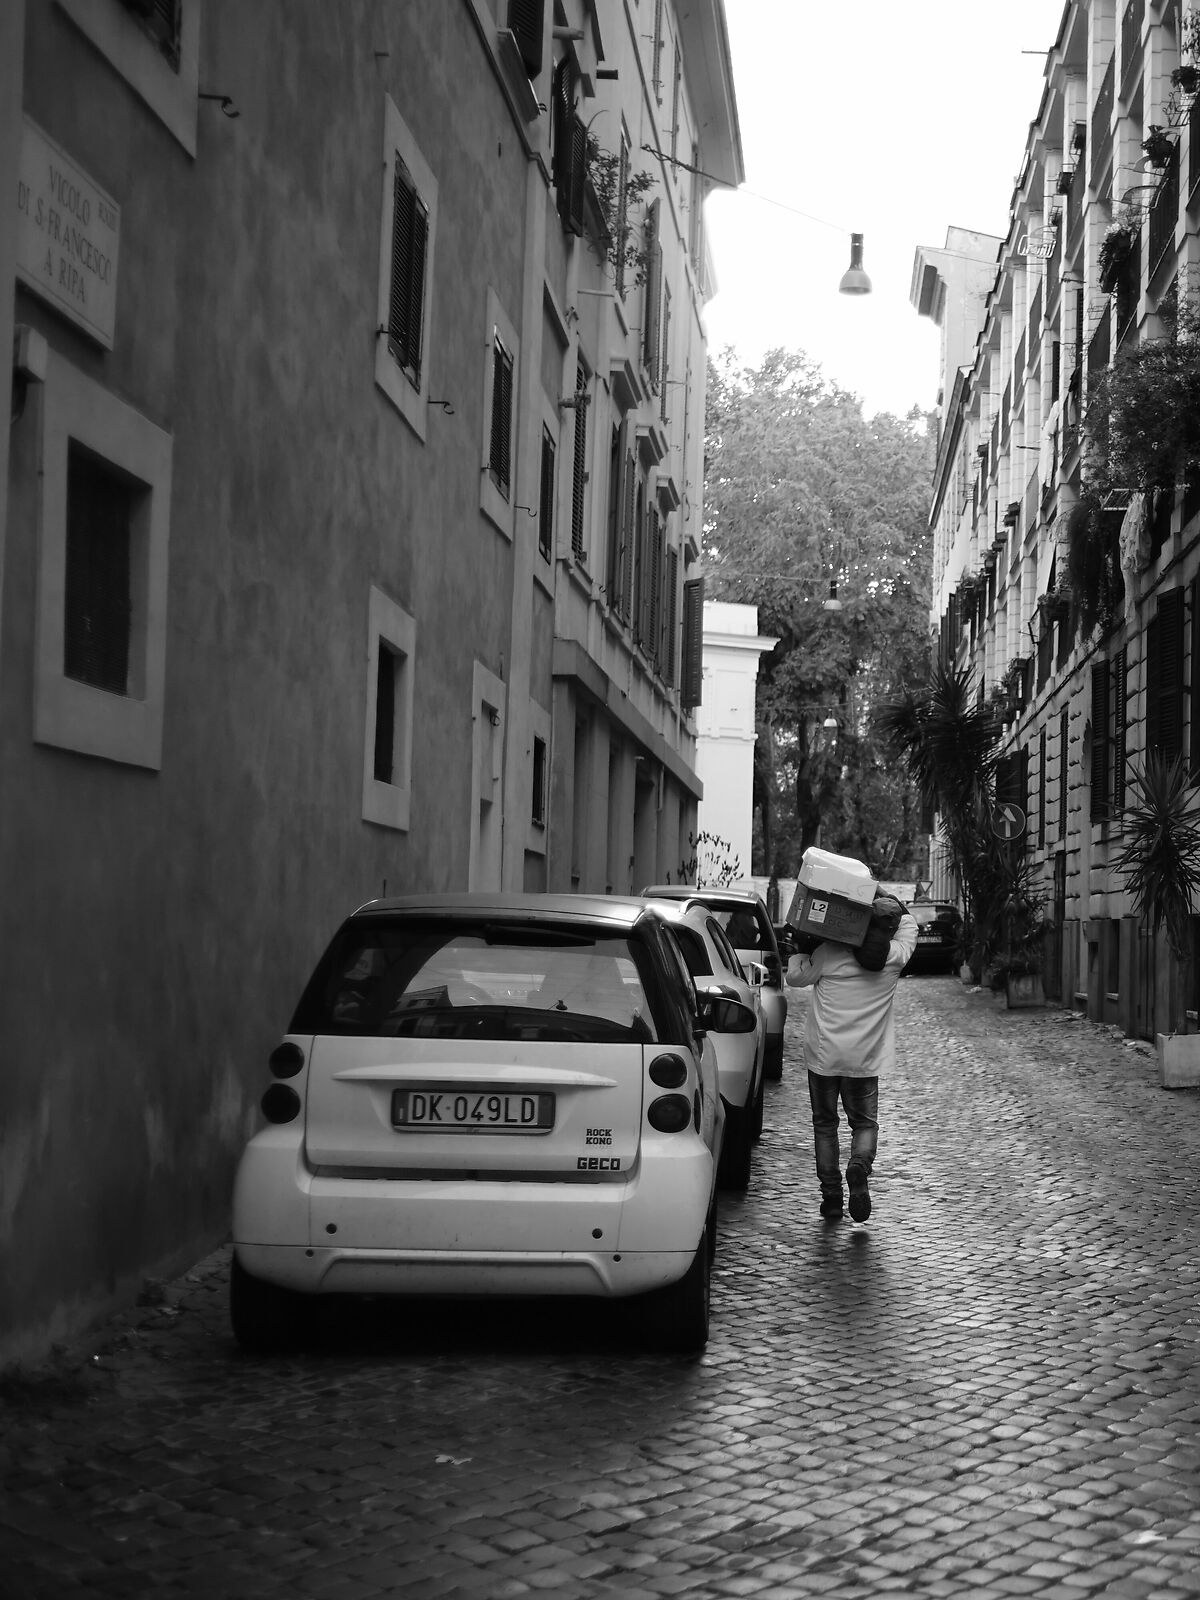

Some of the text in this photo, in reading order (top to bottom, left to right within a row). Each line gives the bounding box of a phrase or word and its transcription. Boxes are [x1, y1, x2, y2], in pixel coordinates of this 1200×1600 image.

[49, 164, 91, 226] VICOLO
[18, 180, 31, 216] DI
[48, 208, 112, 286] FRANCESCO
[43, 247, 86, 304] A RIPA
[811, 901, 827, 913] L2
[585, 1136, 613, 1145] KONG
[586, 1128, 613, 1137] ROCK
